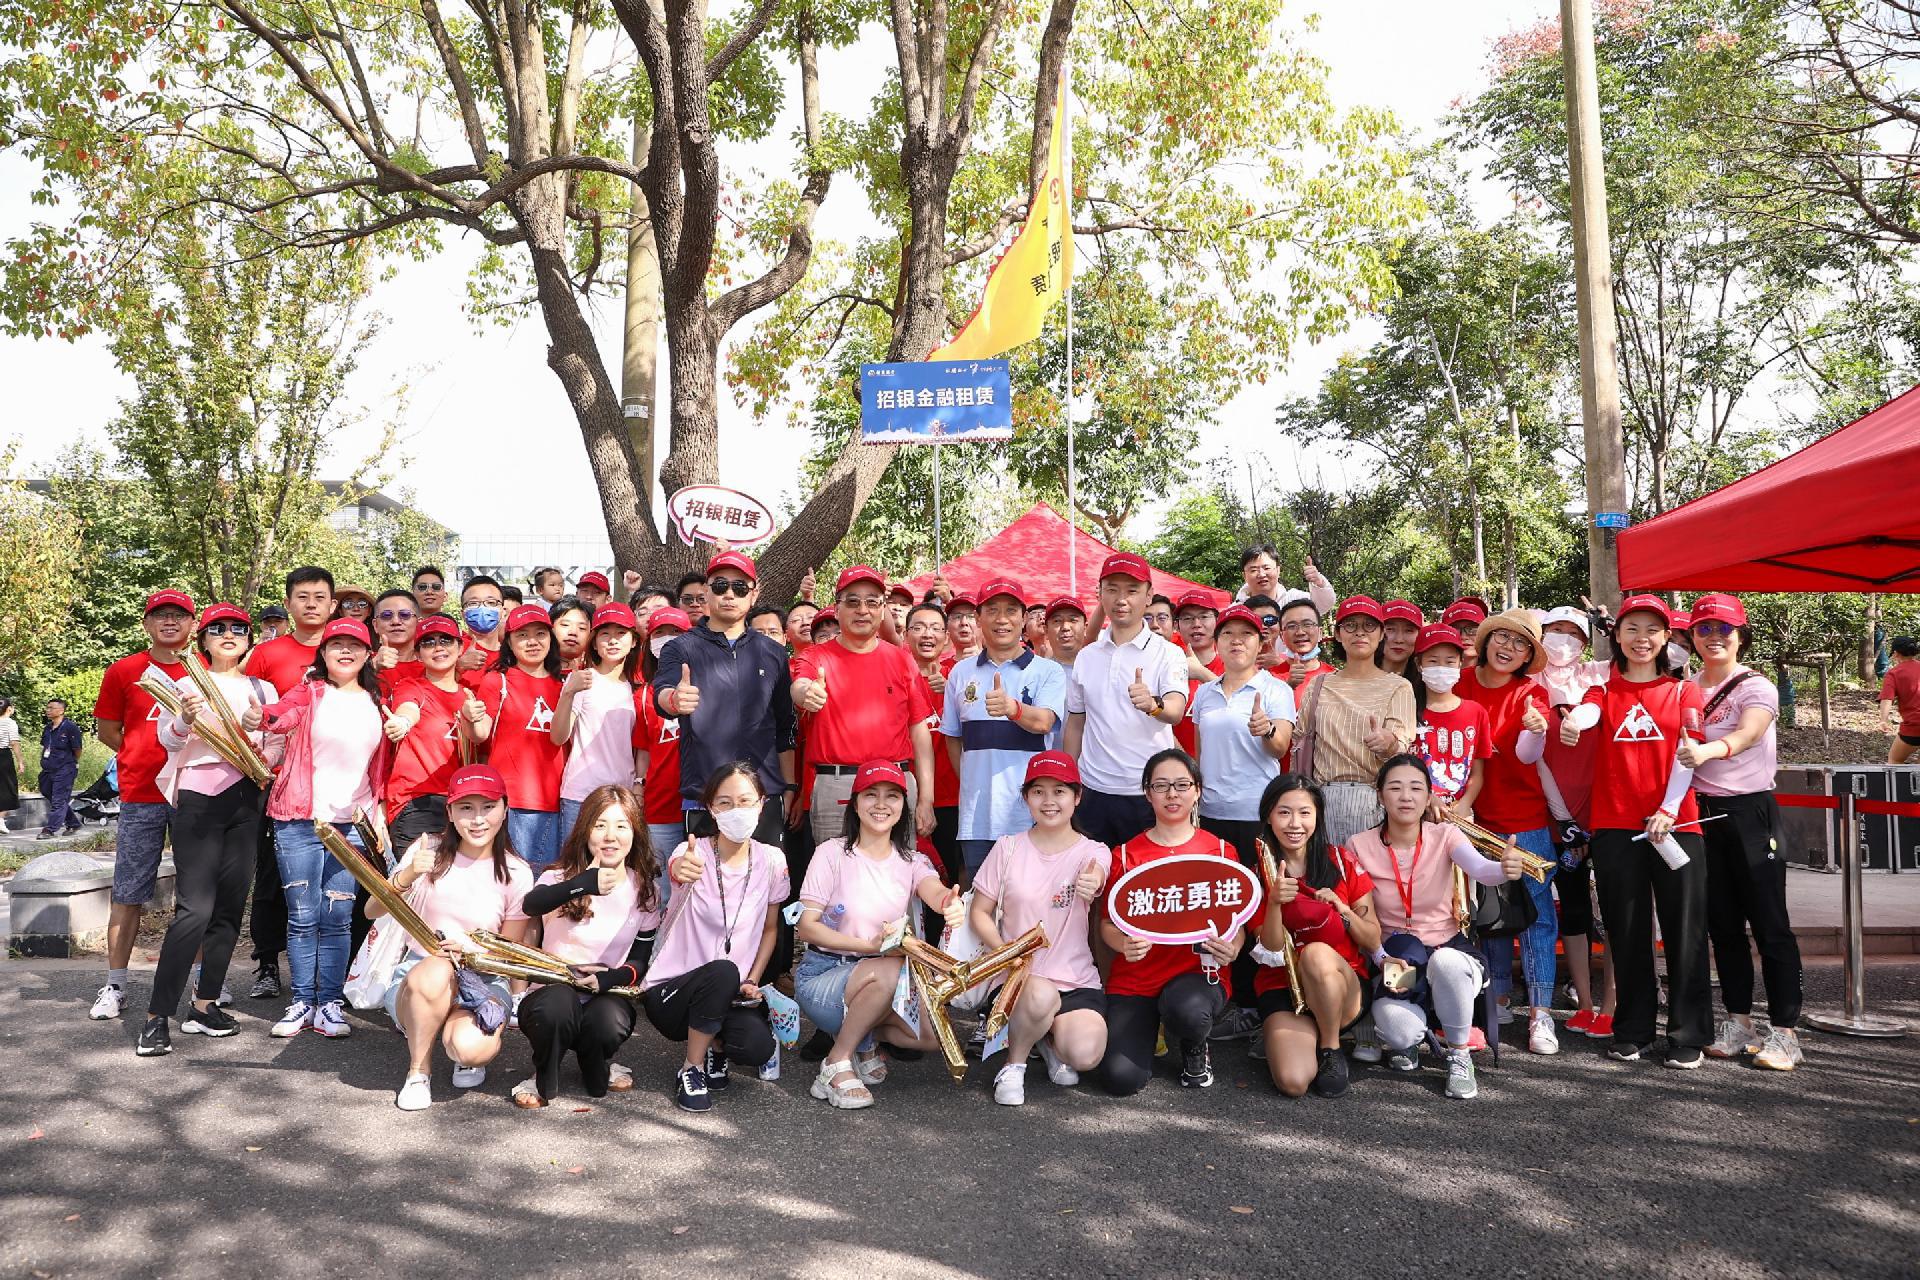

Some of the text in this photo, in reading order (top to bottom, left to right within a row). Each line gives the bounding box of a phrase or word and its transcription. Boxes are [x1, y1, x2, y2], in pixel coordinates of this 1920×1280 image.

[877, 386, 994, 409] 招银金融租赁
[685, 498, 761, 529] 招银租赁
[1127, 877, 1243, 917] 激流勇进
